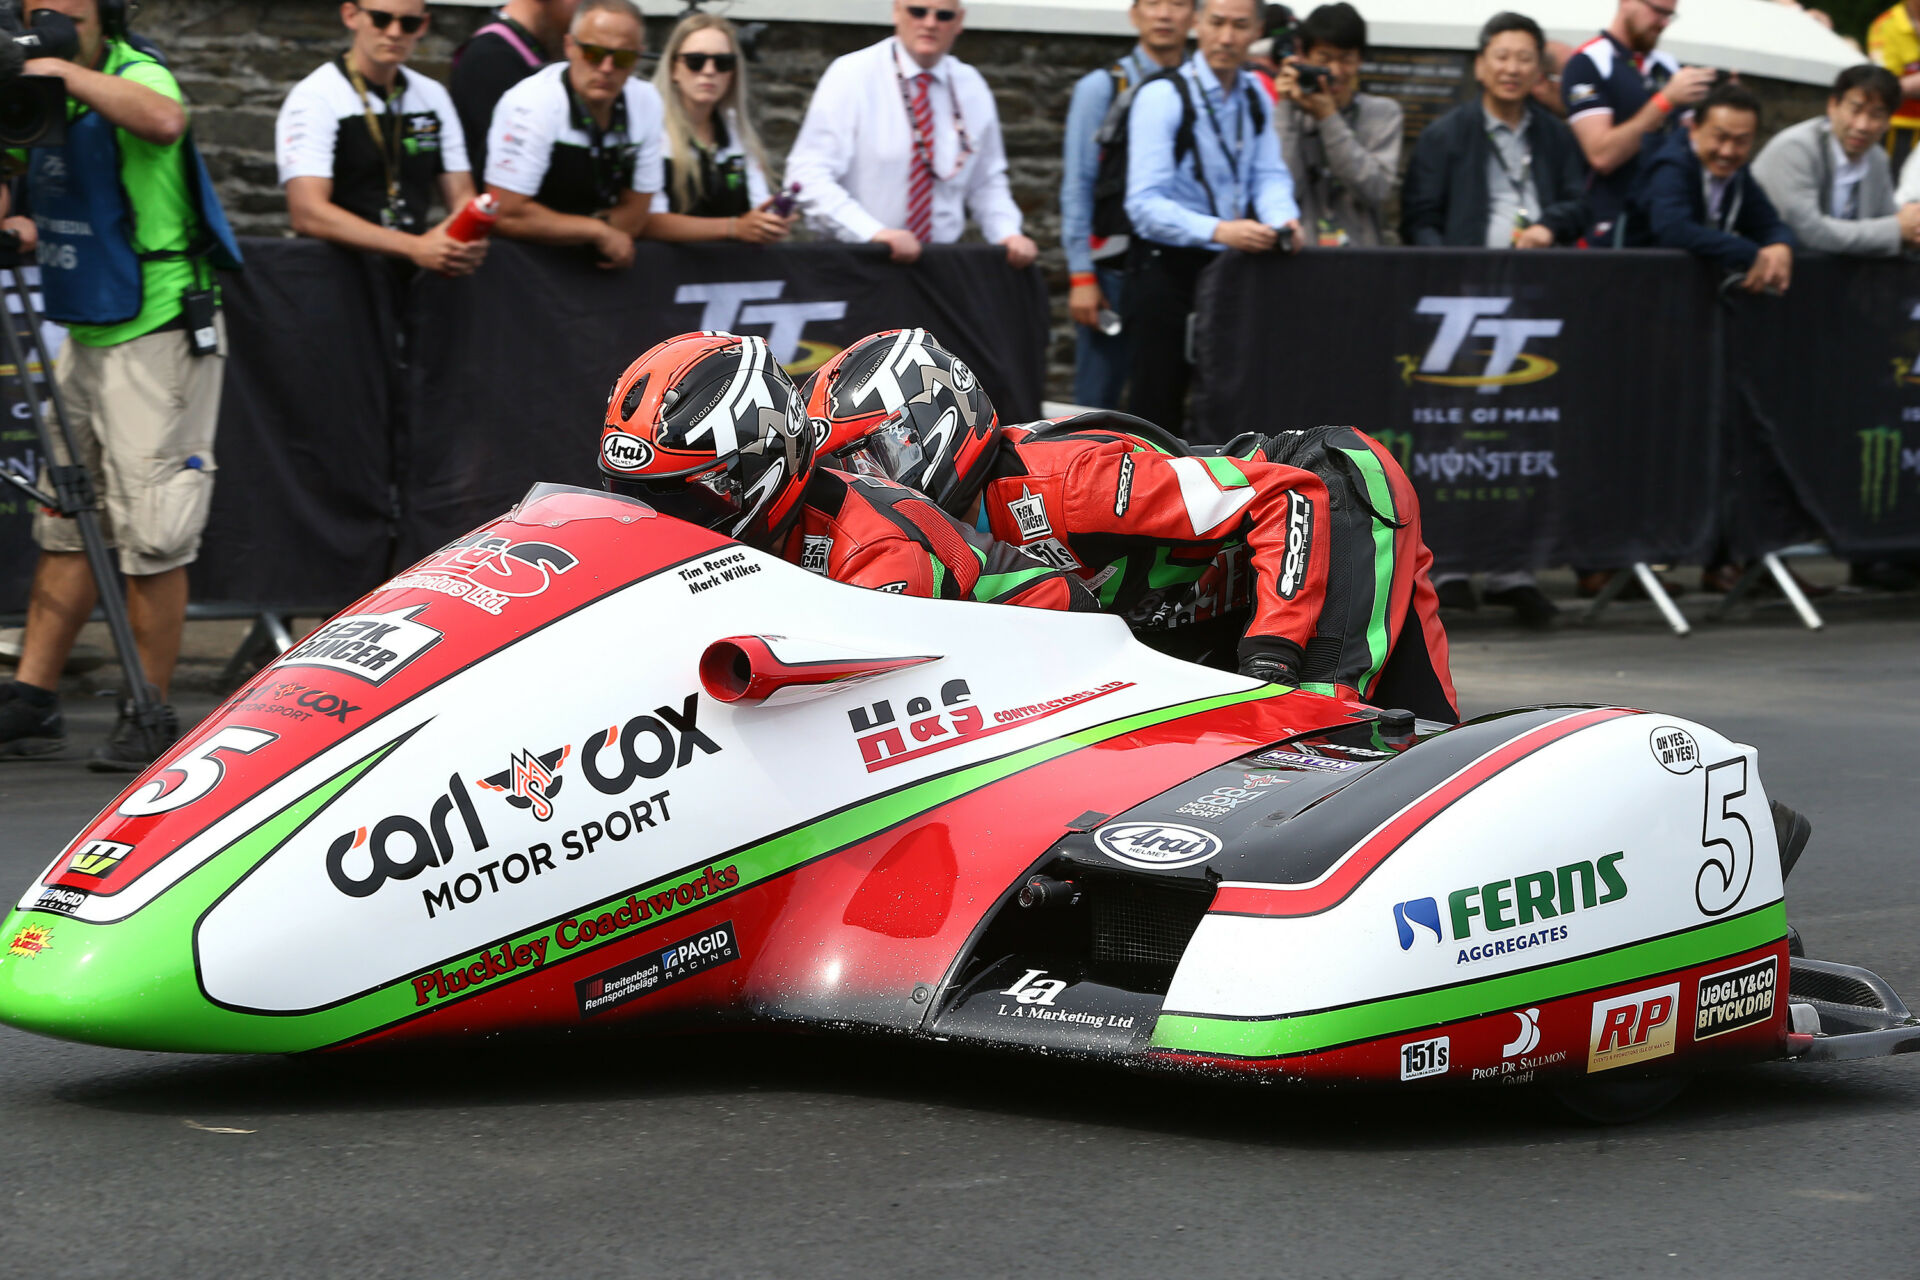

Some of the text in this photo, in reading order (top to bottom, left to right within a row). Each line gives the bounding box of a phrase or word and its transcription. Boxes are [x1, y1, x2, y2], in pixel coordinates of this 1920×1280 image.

[1415, 296, 1564, 394] TT
[1413, 408, 1560, 424] ISLE OF MAN
[604, 437, 644, 461] Arai
[1413, 447, 1559, 482] MONSTER
[1115, 453, 1131, 516] SCOTT
[1281, 489, 1305, 596] SCOTT
[678, 552, 745, 581] Tim Reeves
[688, 562, 762, 595] Mark Wilkes
[285, 639, 399, 671] CANCER
[268, 704, 313, 722] SPORT
[847, 679, 1124, 764] H&S CONTRACTORS LTD
[1656, 737, 1668, 750] OH
[1663, 745, 1695, 764] OH YES!
[116, 725, 281, 817] 5
[325, 771, 490, 898] carl
[581, 692, 723, 796] cox
[1184, 802, 1230, 814] MOTOR
[1176, 807, 1222, 819] SPORT
[1106, 828, 1210, 854] Arai
[1128, 847, 1168, 858] HELMET
[1695, 755, 1754, 917] 5
[421, 790, 672, 919] MOTOR SPORT
[52, 889, 86, 906] PAGID
[1448, 850, 1628, 940] FERNS
[411, 864, 741, 1006] Pluckley Coachworks
[1456, 925, 1569, 965] AGGREGATES
[604, 930, 729, 993] Breitenbach PAGID
[585, 947, 733, 1011] Rennsportbeläge RACING
[997, 1004, 1135, 1029] L A Marketing Ltd
[1595, 994, 1675, 1054] RP
[1402, 1040, 1448, 1074] 151's
[1472, 1066, 1499, 1081] PROF.
